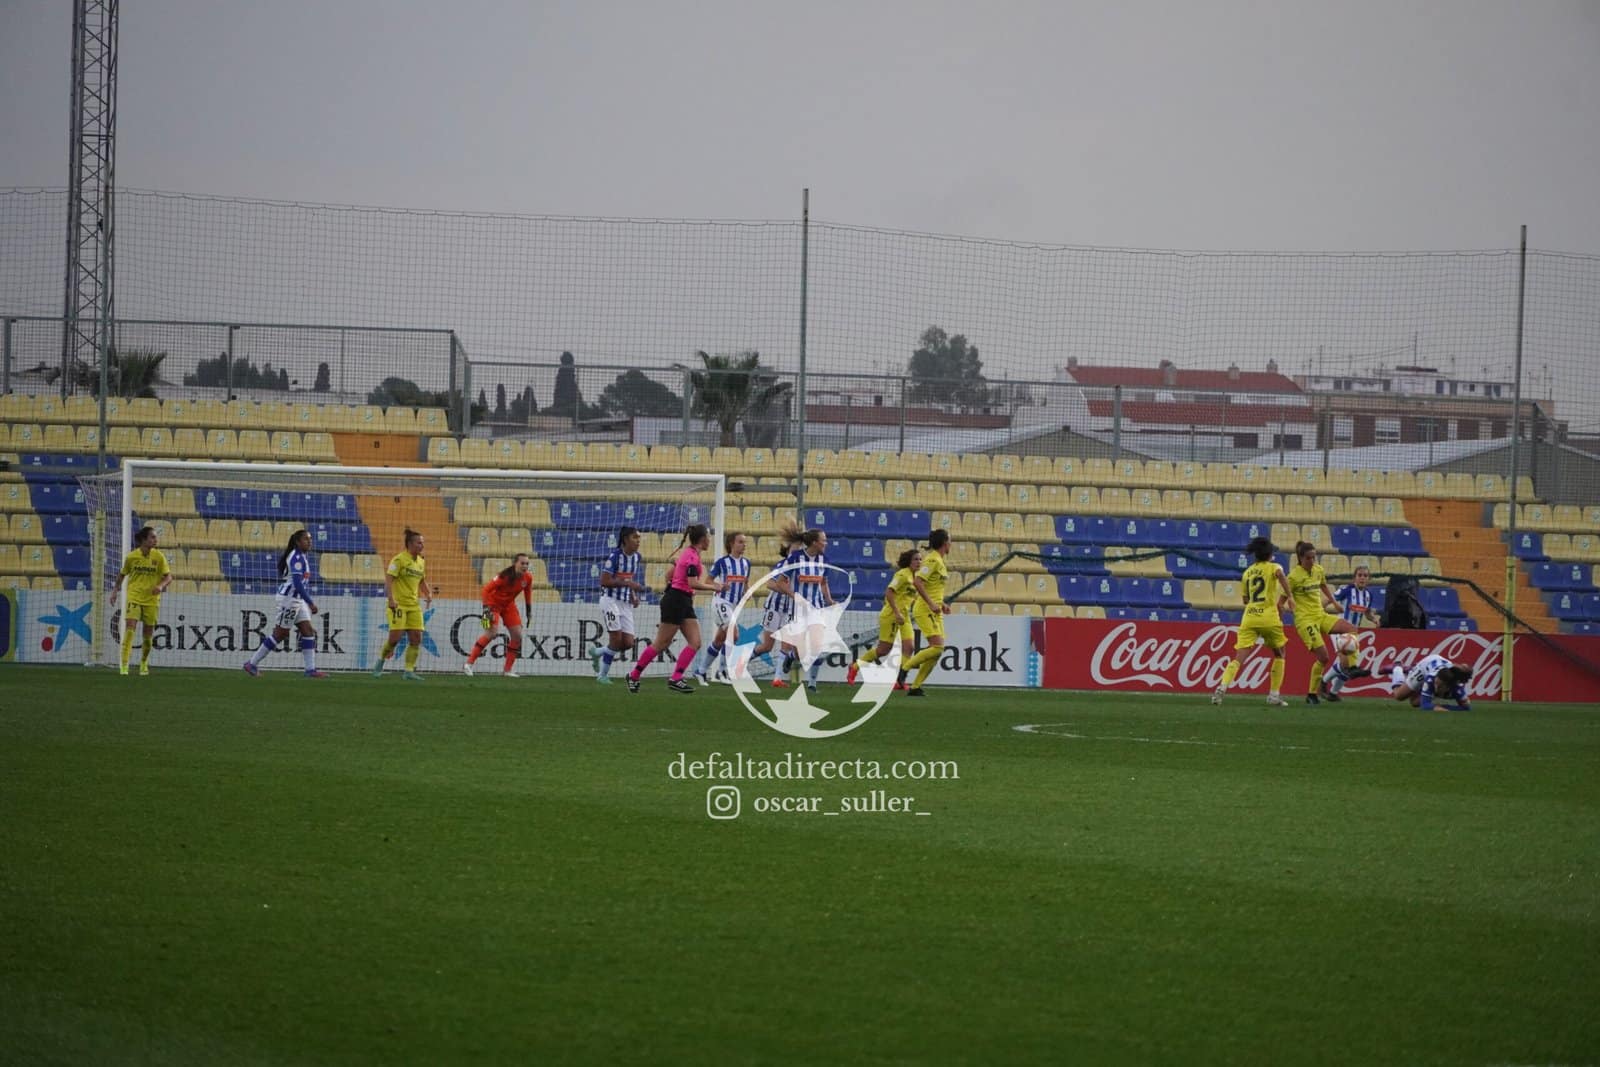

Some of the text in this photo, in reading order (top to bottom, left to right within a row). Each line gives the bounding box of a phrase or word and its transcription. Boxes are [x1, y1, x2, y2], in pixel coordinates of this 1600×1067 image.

[1246, 577, 1266, 602] 12
[720, 603, 727, 613] 6
[284, 609, 296, 620] 22
[606, 611, 616, 621] 16
[767, 611, 774, 621] 8
[1306, 624, 1320, 637] 21
[1090, 622, 1272, 689] Coca-Cola
[1336, 631, 1519, 698] Coca-Cla
